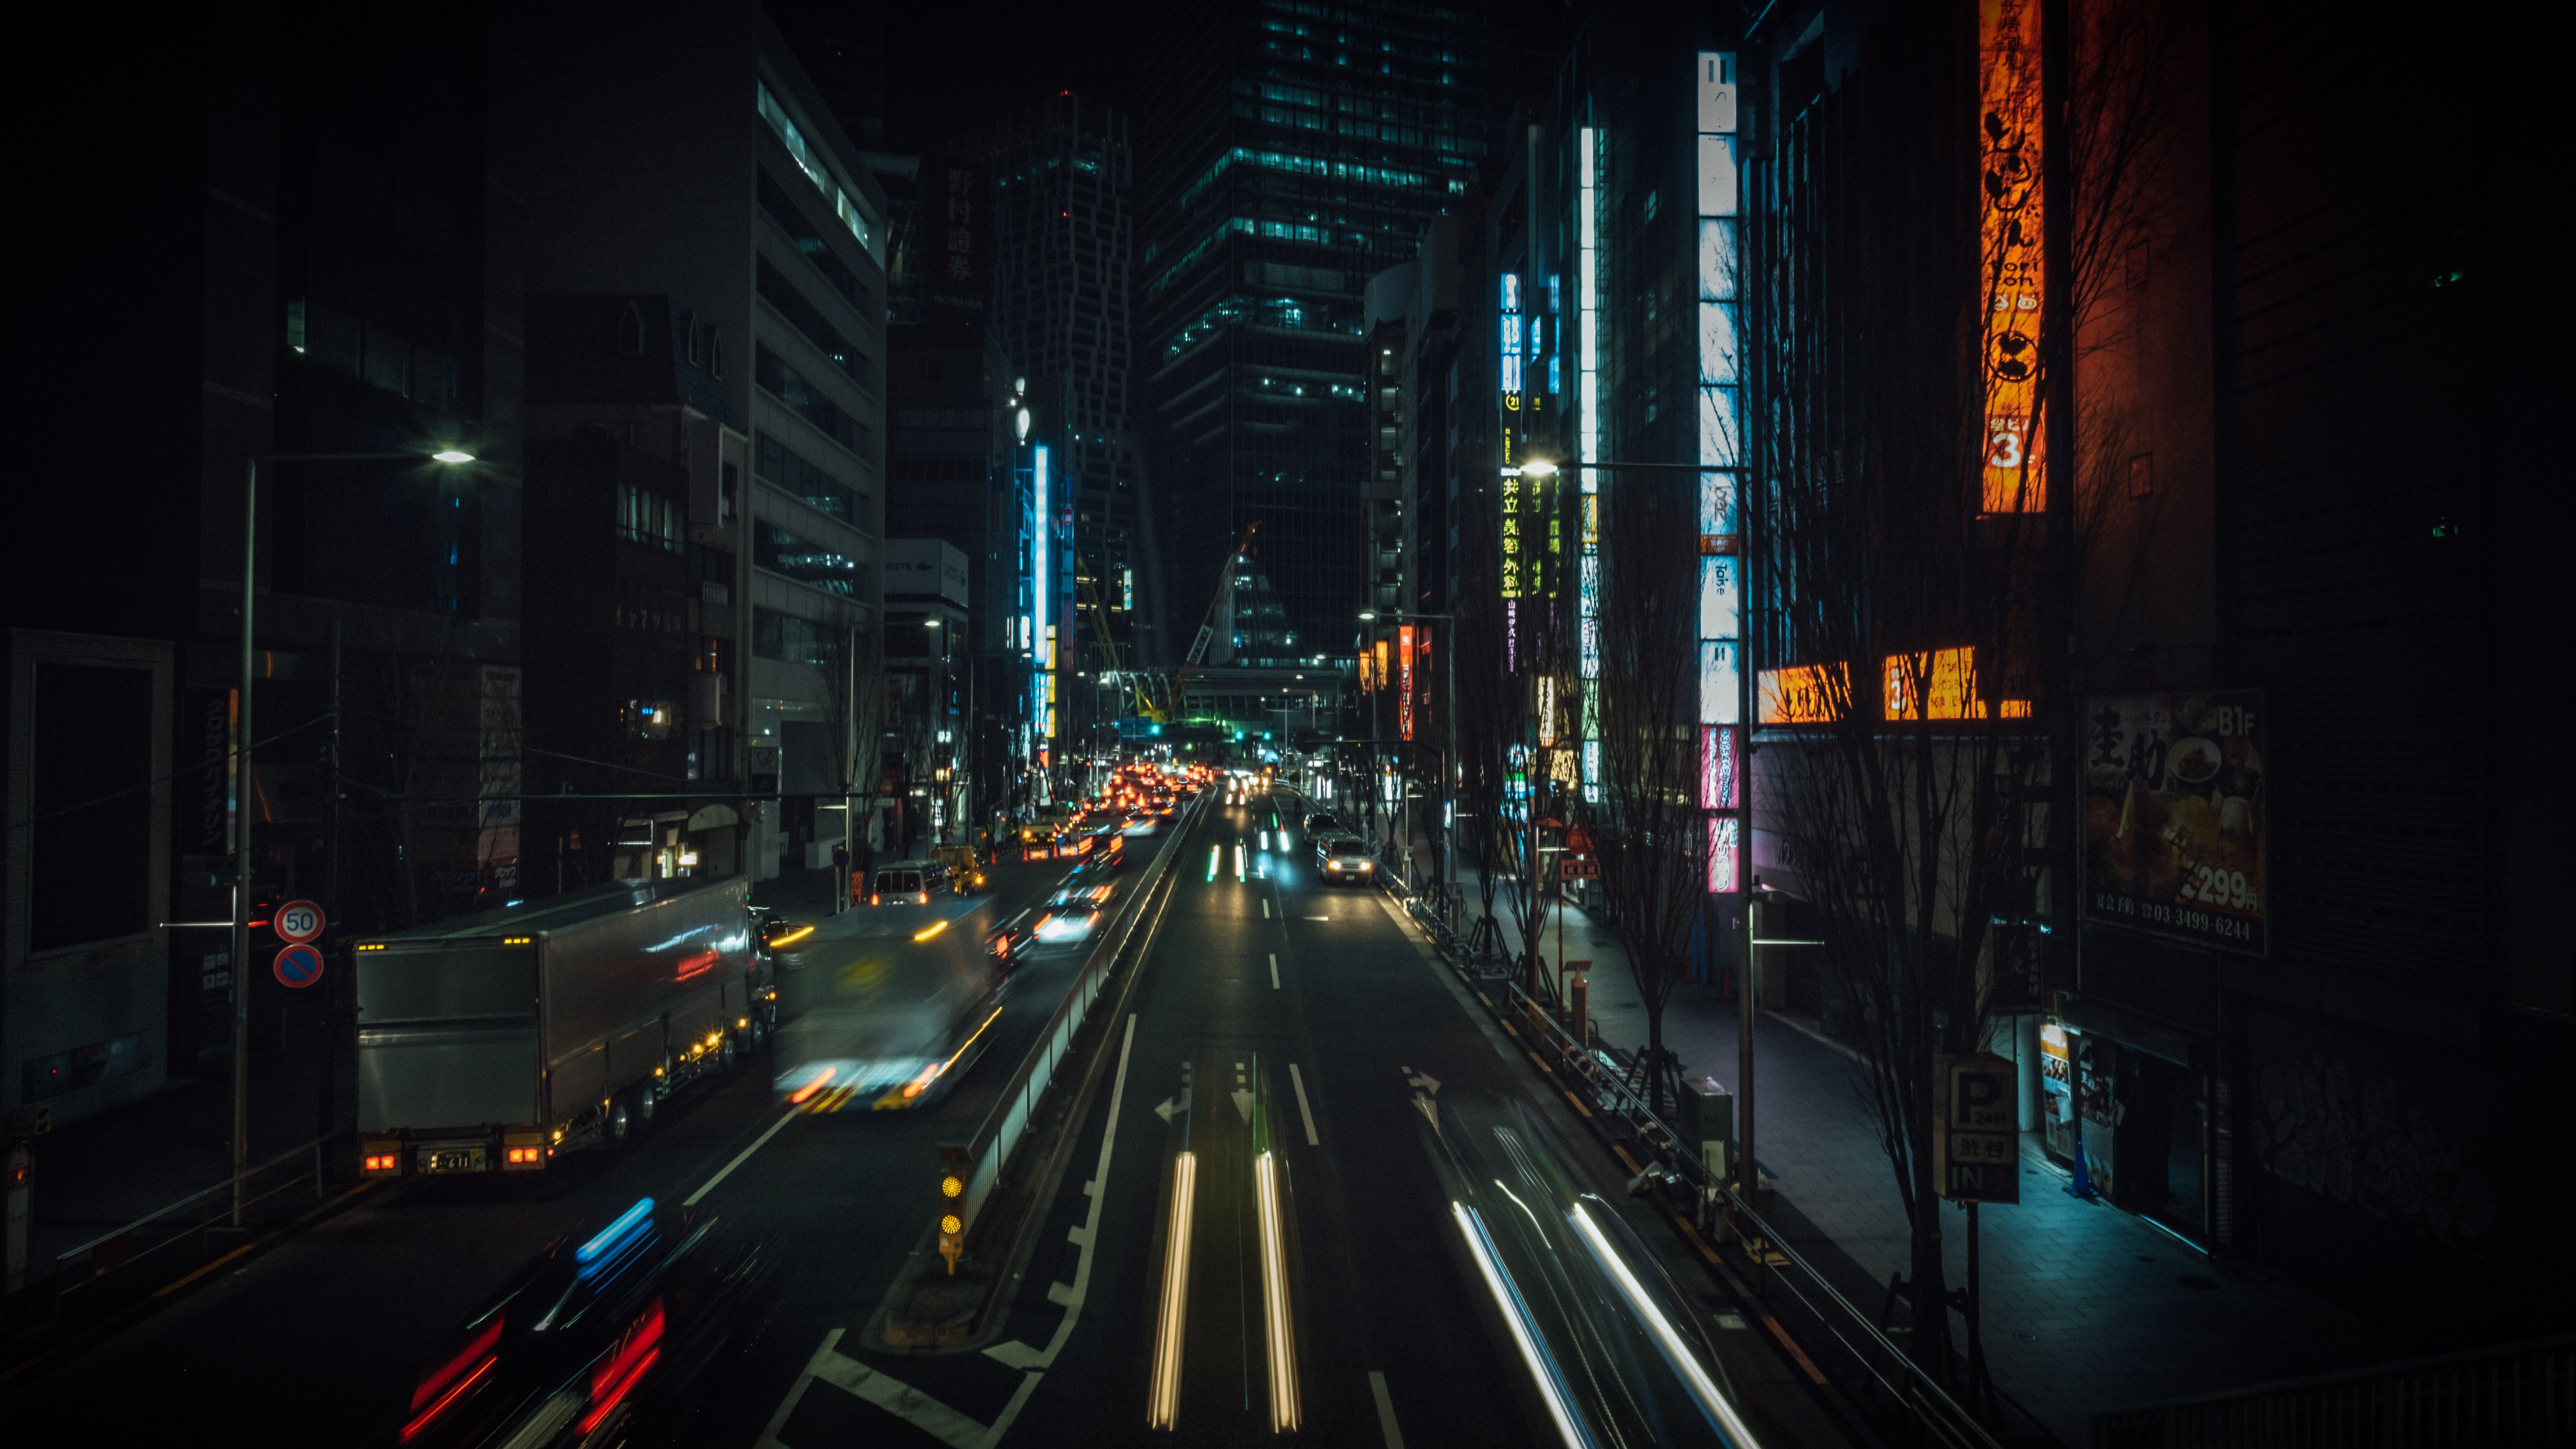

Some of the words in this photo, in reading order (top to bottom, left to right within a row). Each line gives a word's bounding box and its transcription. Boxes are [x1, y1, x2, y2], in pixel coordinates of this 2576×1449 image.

[933, 292, 983, 309] NOMURA
[2218, 706, 2256, 737] B1F
[2090, 704, 2167, 791] 圭助
[287, 913, 313, 931] 50
[2153, 903, 2249, 941] 03-3499-6244
[1958, 1073, 2001, 1124] P
[1974, 1112, 2006, 1126] 24H
[1959, 1138, 2004, 1159] 渋谷
[1951, 1167, 1984, 1191] IN
